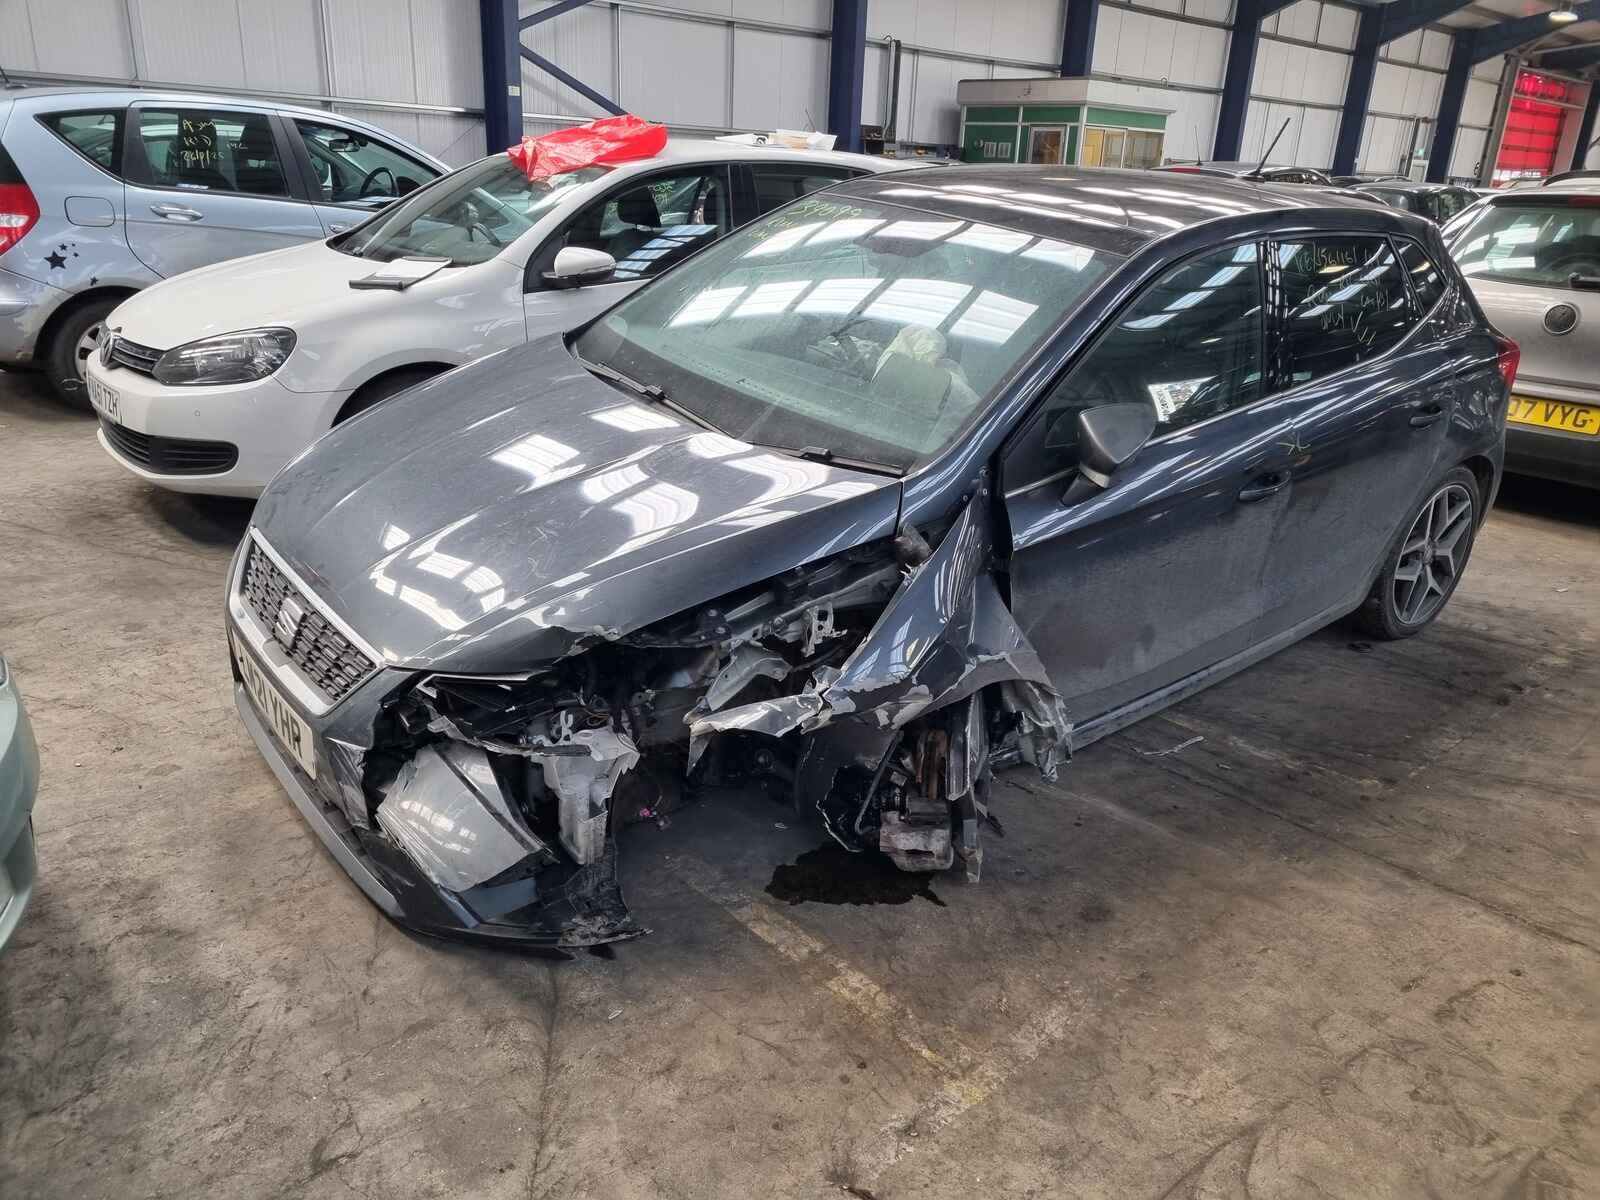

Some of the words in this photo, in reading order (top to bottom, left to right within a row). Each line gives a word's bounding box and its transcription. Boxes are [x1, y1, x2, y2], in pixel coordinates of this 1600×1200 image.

[103, 387, 118, 417] TZH
[1543, 402, 1590, 428] VYG
[269, 687, 303, 760] YHR
